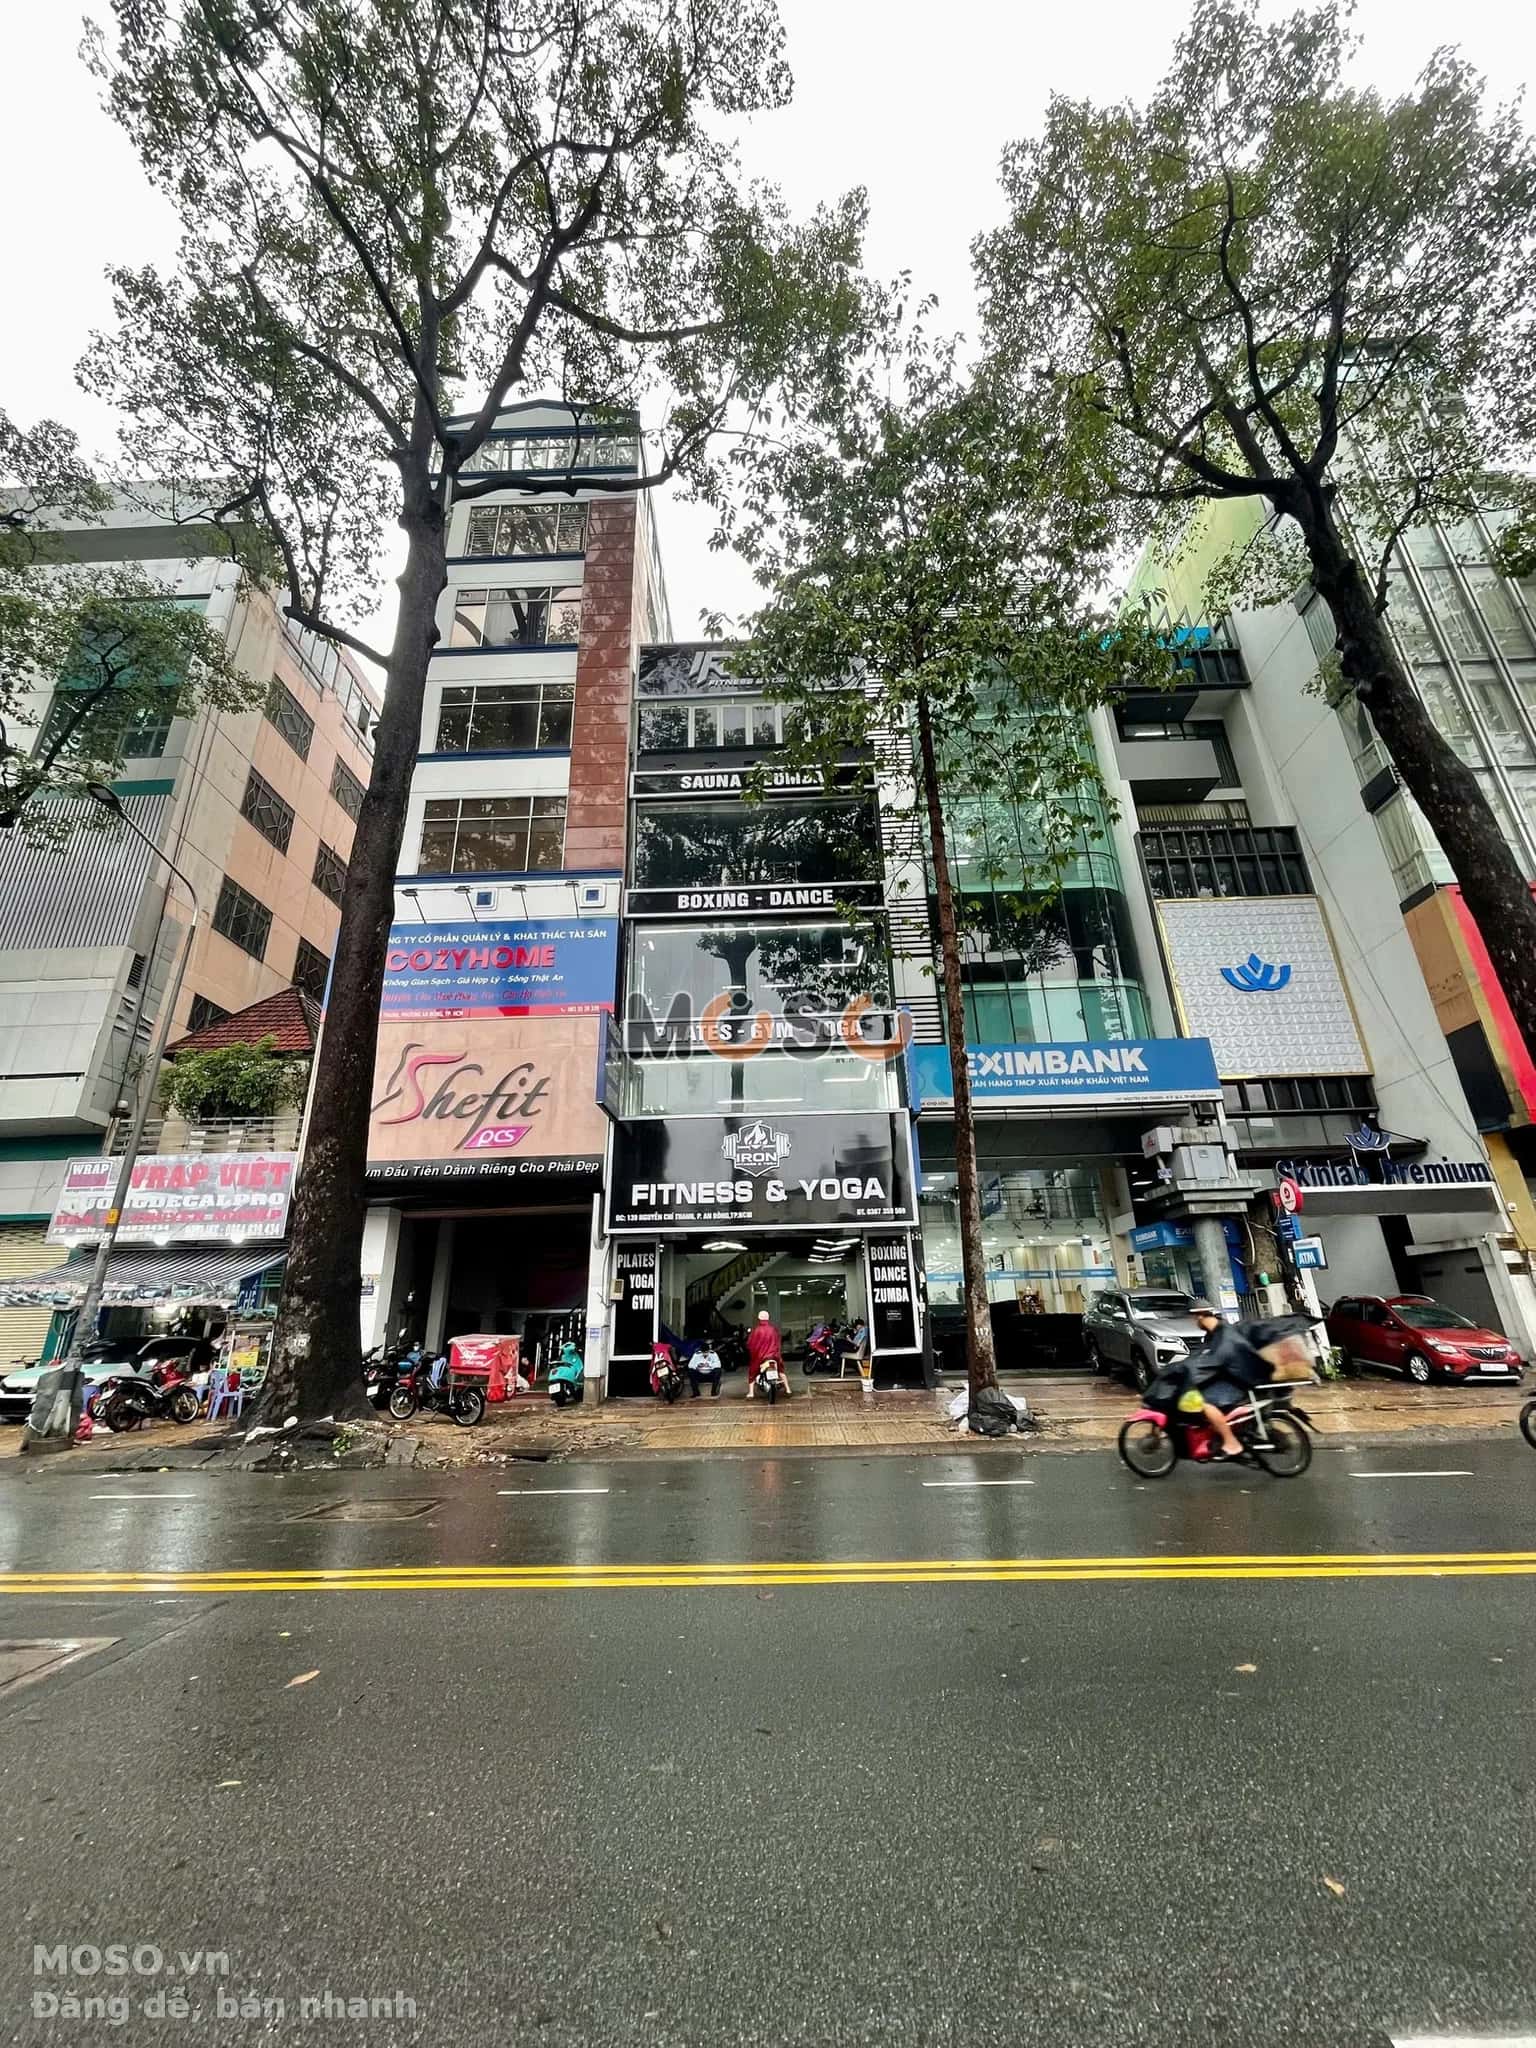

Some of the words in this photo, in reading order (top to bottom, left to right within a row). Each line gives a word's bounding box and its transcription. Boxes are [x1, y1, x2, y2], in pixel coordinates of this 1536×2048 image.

[680, 774, 741, 789] SAUNA
[677, 892, 749, 909] BOXING
[769, 889, 834, 906] DANCE
[503, 933, 510, 941] &
[514, 932, 537, 941] KHAI
[541, 929, 566, 940] THÁC
[386, 944, 555, 972] COZYHOME
[751, 1021, 793, 1039] GYM
[811, 1020, 863, 1037] YOGA
[966, 1047, 1149, 1077] EXIMBANK
[1015, 1078, 1036, 1087] TMCP
[1129, 1075, 1149, 1084] NAM
[379, 1053, 551, 1151] Shefit
[477, 1128, 516, 1147] pcs
[736, 1152, 777, 1162] IRON
[73, 1164, 109, 1175] WRAP
[219, 1157, 291, 1188] VIỆT
[413, 1164, 440, 1176] Tiên
[480, 1161, 515, 1177] Riêng
[519, 1162, 545, 1173] Cho
[547, 1159, 574, 1172] Phái
[576, 1160, 600, 1174] Đẹp
[1276, 1159, 1369, 1187] Skinlab
[1379, 1157, 1492, 1185] Premium
[631, 1180, 752, 1206] FITNESS
[766, 1180, 788, 1202] &
[799, 1177, 886, 1201] YOGA
[617, 1253, 655, 1268] PILATES
[870, 1246, 907, 1261] BOXING
[1298, 1251, 1317, 1266] ATM
[629, 1273, 654, 1289] YOGA
[873, 1266, 908, 1282] DANCE
[632, 1294, 654, 1310] GYM
[873, 1287, 910, 1303] ZUMBA
